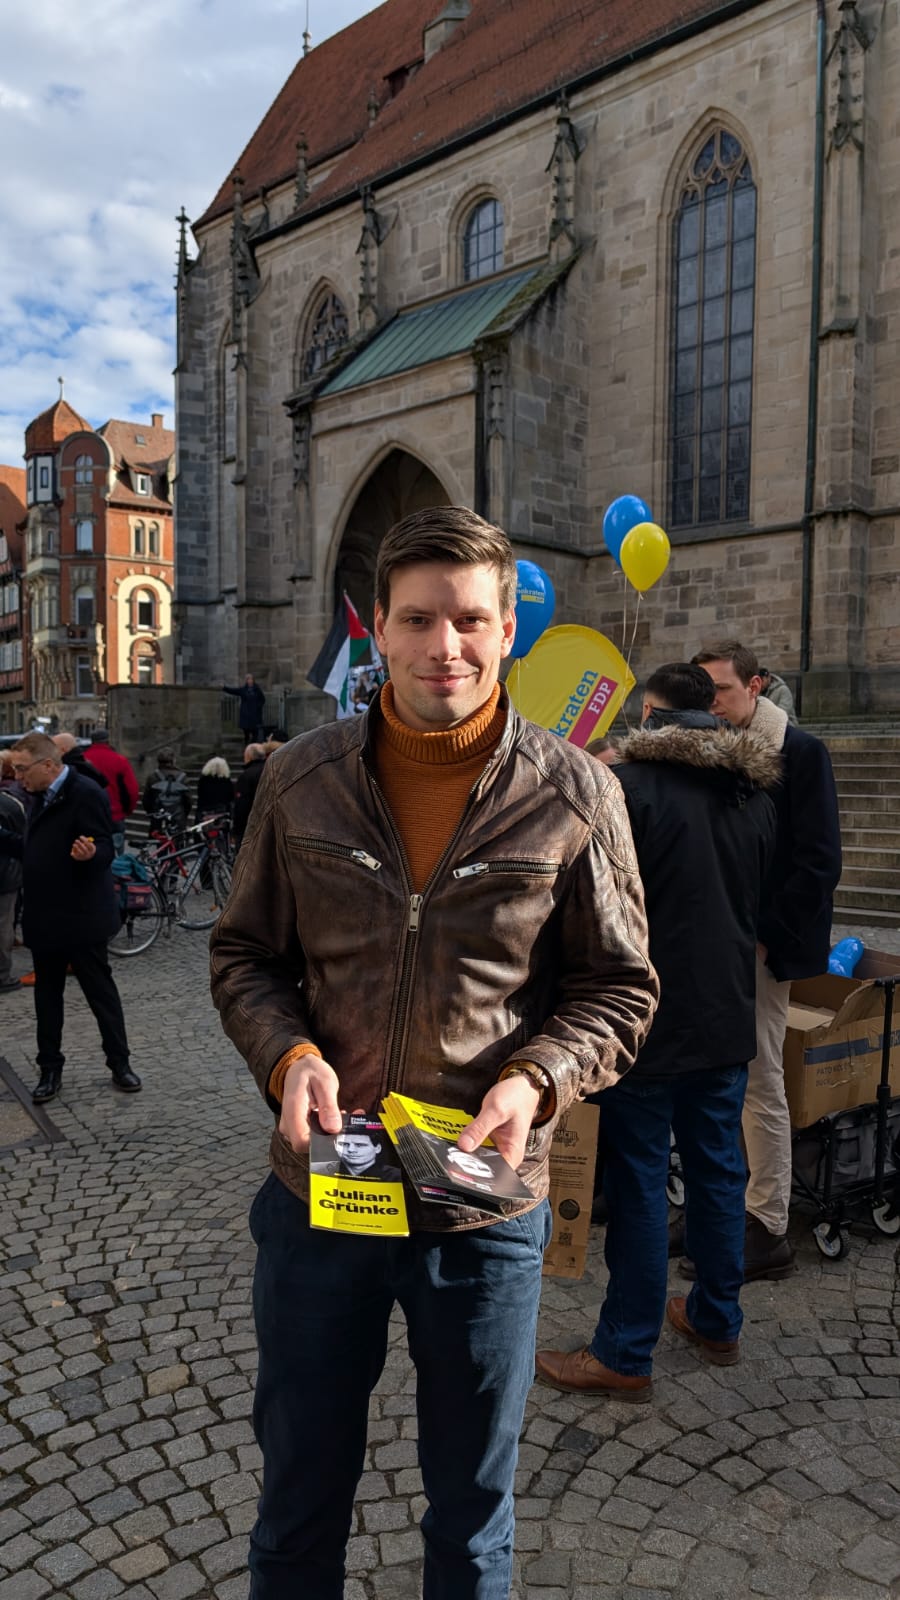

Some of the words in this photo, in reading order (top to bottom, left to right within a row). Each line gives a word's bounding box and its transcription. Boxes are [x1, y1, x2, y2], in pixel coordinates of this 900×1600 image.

[588, 681, 613, 715] FDP
[325, 1188, 391, 1202] Julian
[319, 1199, 399, 1215] Grünke
